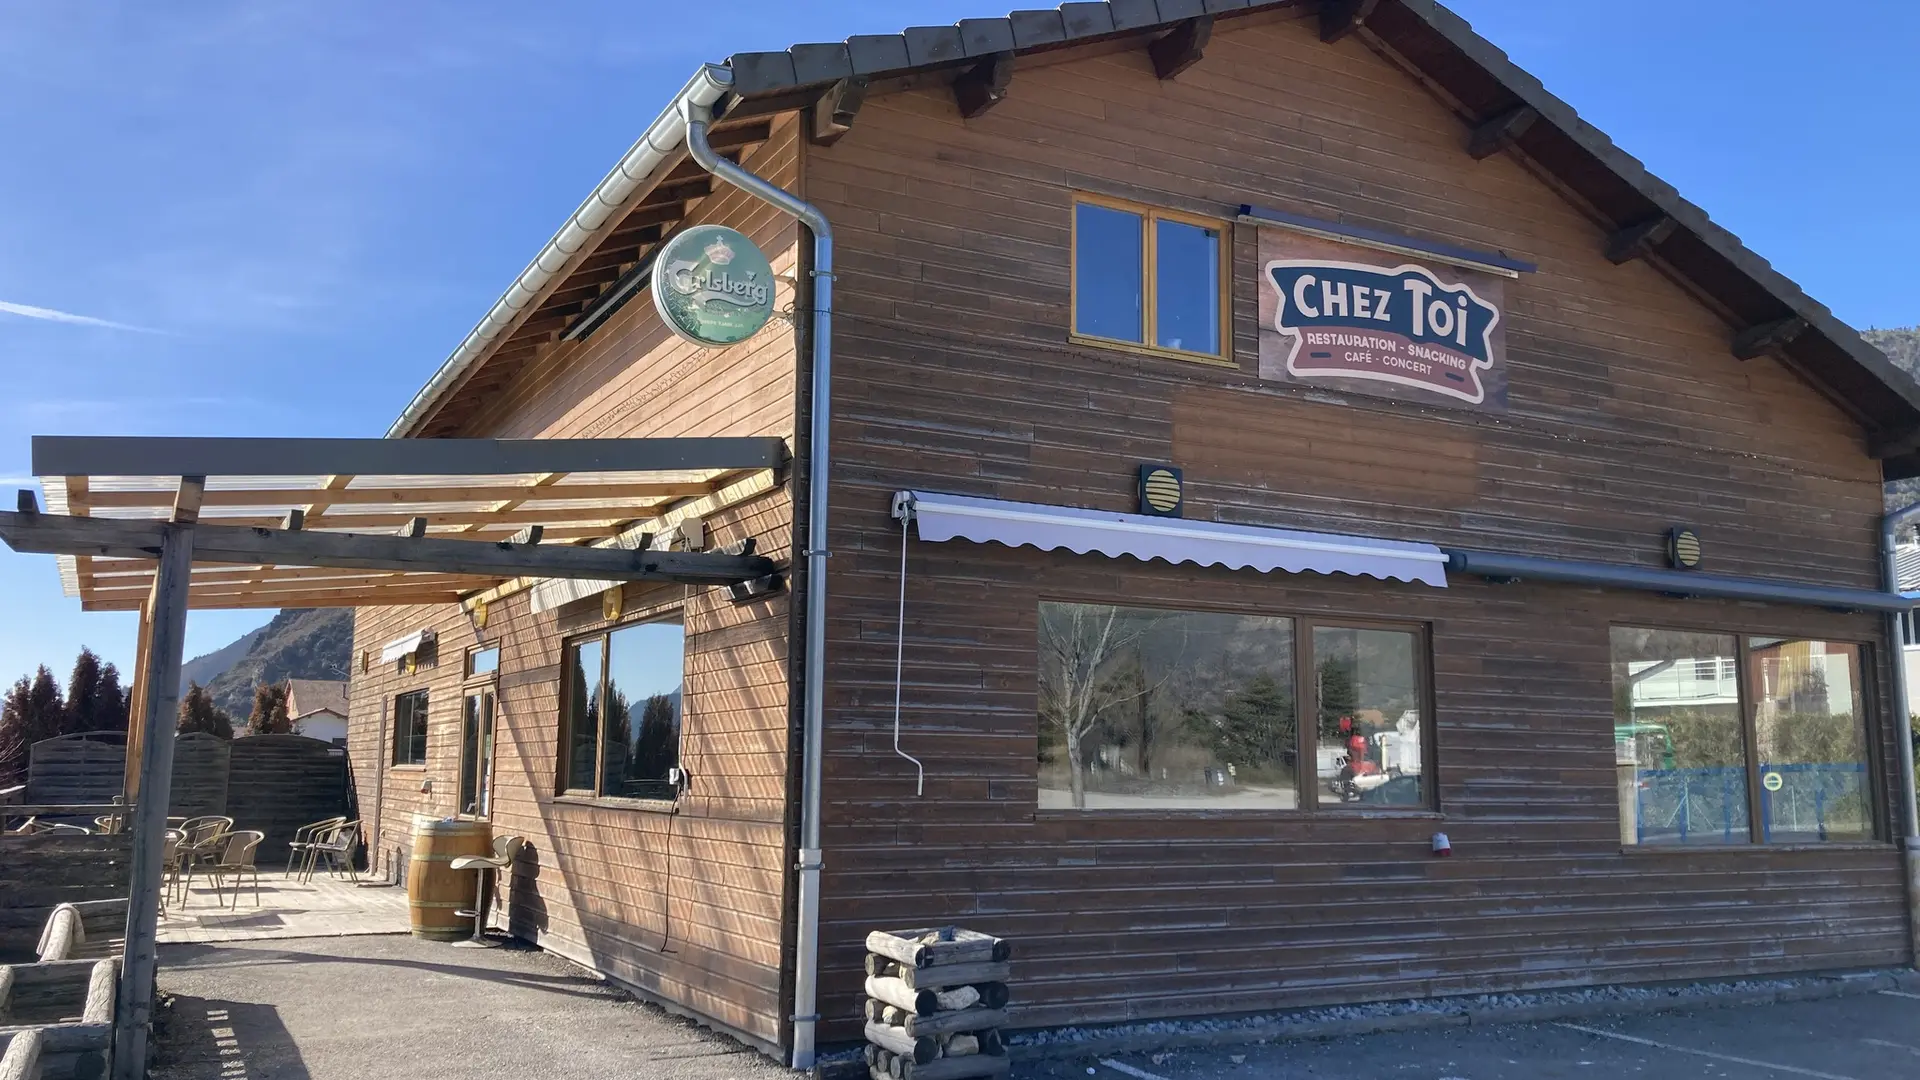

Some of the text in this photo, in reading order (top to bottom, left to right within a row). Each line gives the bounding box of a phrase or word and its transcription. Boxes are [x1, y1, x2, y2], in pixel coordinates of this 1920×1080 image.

[664, 260, 768, 305] Carlsberg
[1293, 274, 1468, 347] CHEZ Toi
[1306, 332, 1397, 352] RESTAURATION
[1407, 343, 1467, 370] SNACKING
[1344, 350, 1372, 364] CAFÉ
[1382, 355, 1433, 375] CONCERT
